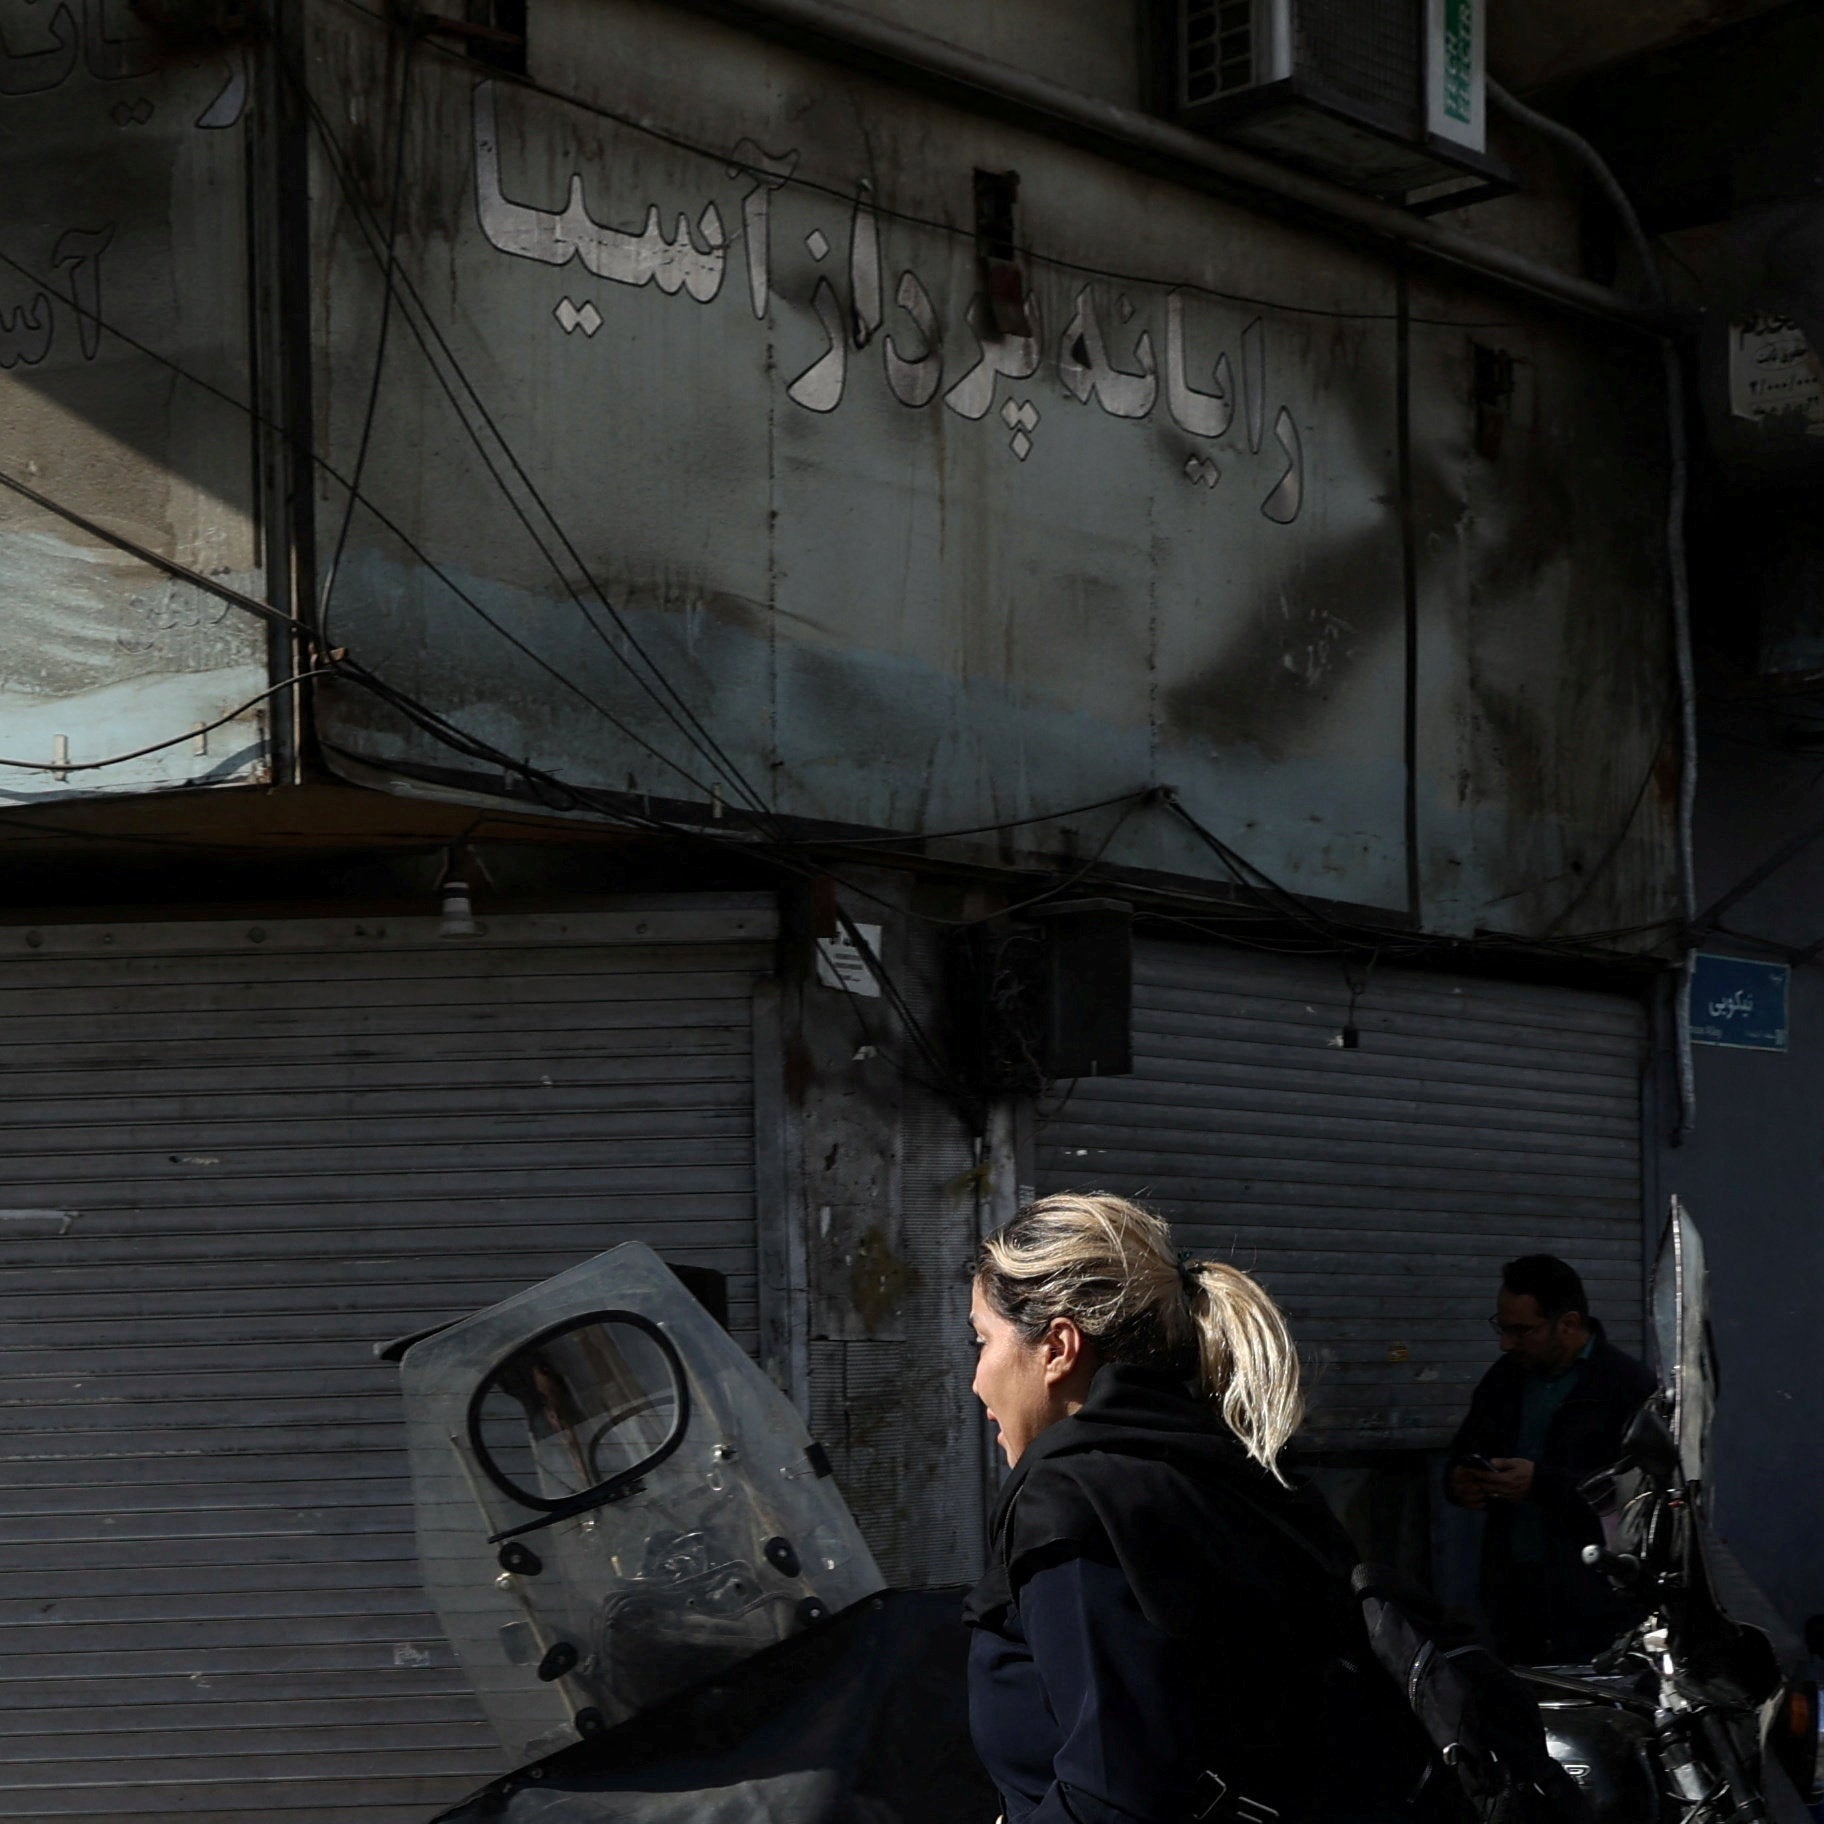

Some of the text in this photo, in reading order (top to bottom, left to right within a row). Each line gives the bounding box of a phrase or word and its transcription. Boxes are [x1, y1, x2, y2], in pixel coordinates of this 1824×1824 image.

[473, 78, 1305, 525] رایانه پرداز آسیا
